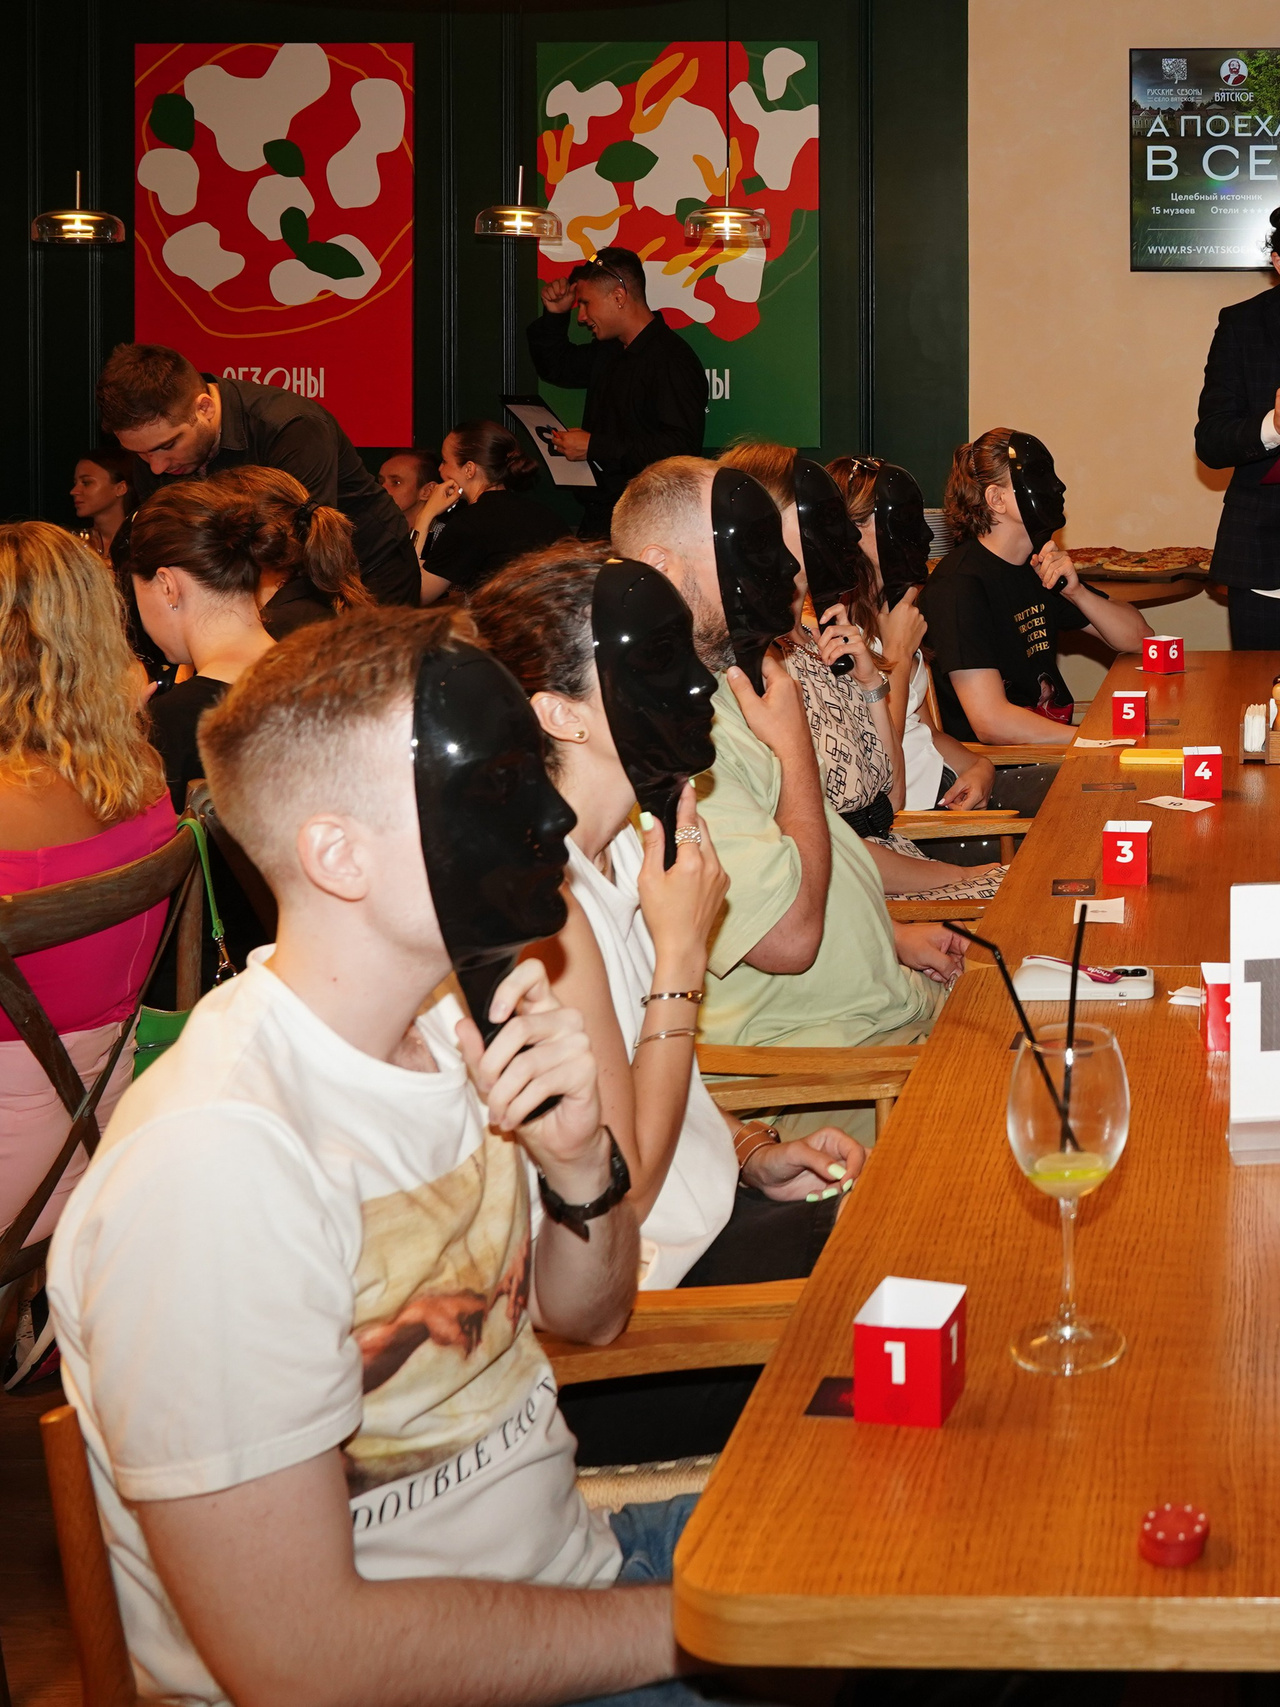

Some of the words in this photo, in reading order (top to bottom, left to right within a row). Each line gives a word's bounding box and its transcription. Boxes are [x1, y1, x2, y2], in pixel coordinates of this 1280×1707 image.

[1214, 91, 1254, 102] ВЯТСКОЕ
[1146, 115, 1170, 137] А
[1147, 146, 1179, 181] В
[1170, 192, 1218, 202] Целебный
[1220, 193, 1263, 201] источник
[1151, 206, 1161, 215] 15
[1163, 207, 1196, 216] музеев
[1210, 206, 1239, 215] Отели
[1148, 644, 1158, 660] 6
[1168, 644, 1179, 660] 6
[1121, 703, 1136, 720] 5
[1194, 761, 1213, 780] 4
[1115, 840, 1134, 864] 3
[884, 1340, 906, 1385] 1
[351, 1434, 492, 1531] DOUBLE
